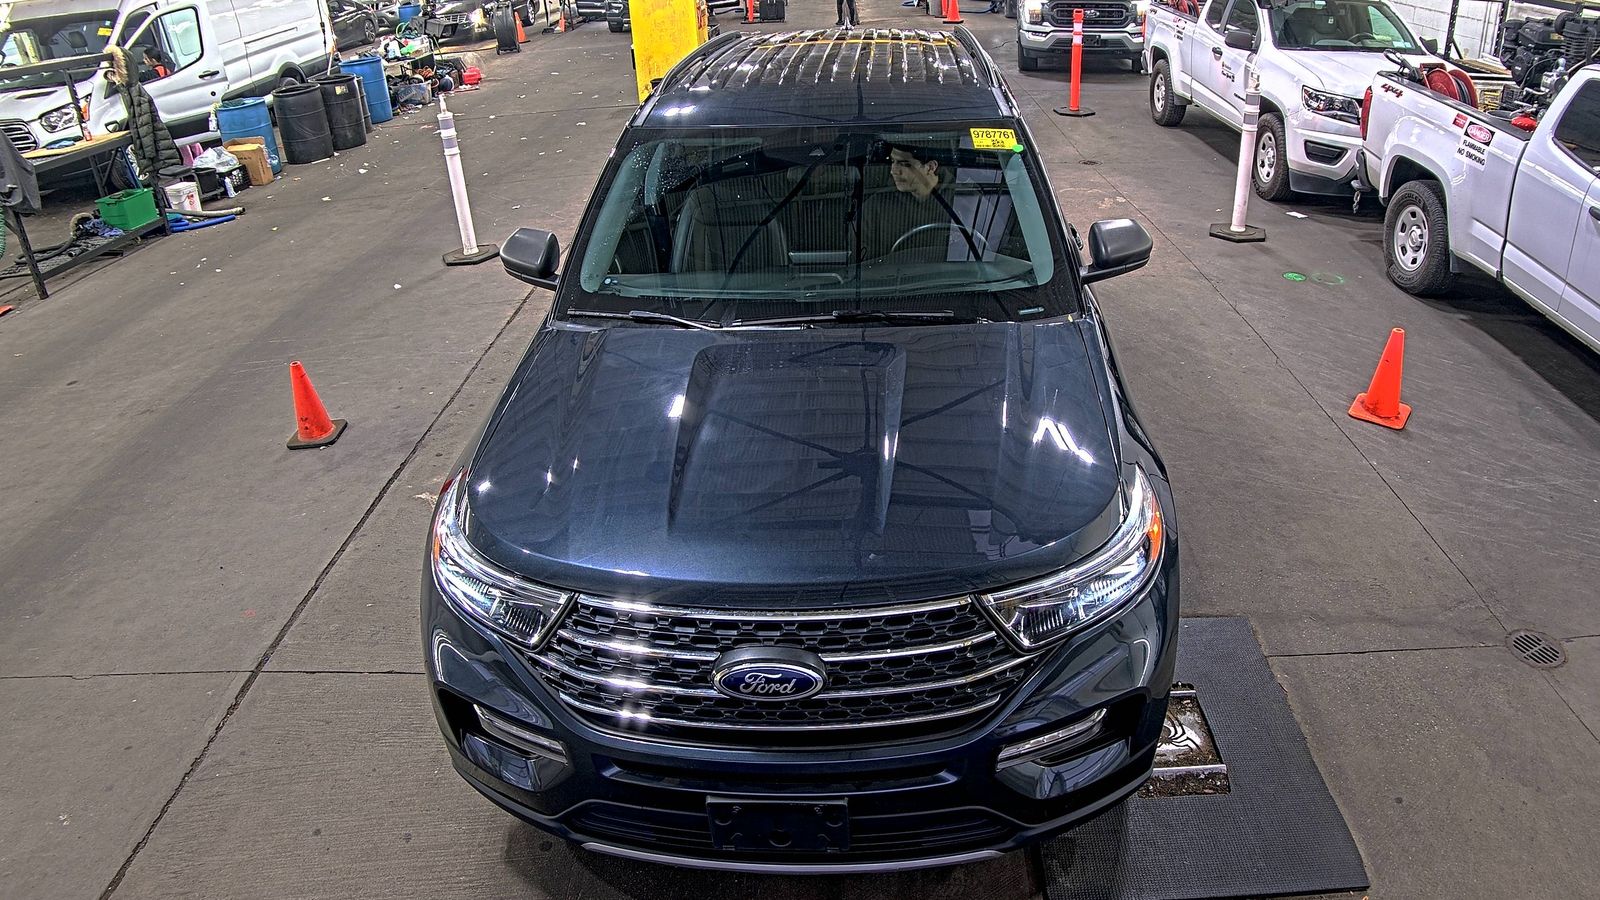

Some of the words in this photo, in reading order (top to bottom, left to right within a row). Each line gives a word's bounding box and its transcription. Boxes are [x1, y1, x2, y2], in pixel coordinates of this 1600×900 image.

[1381, 83, 1403, 98] 4x4
[972, 130, 1014, 139] 9787761
[1468, 126, 1490, 141] DANGER
[1463, 140, 1485, 155] FLAMMABLE
[1457, 147, 1465, 155] NO
[1465, 150, 1485, 166] SMOKING
[740, 672, 797, 694] Ford
